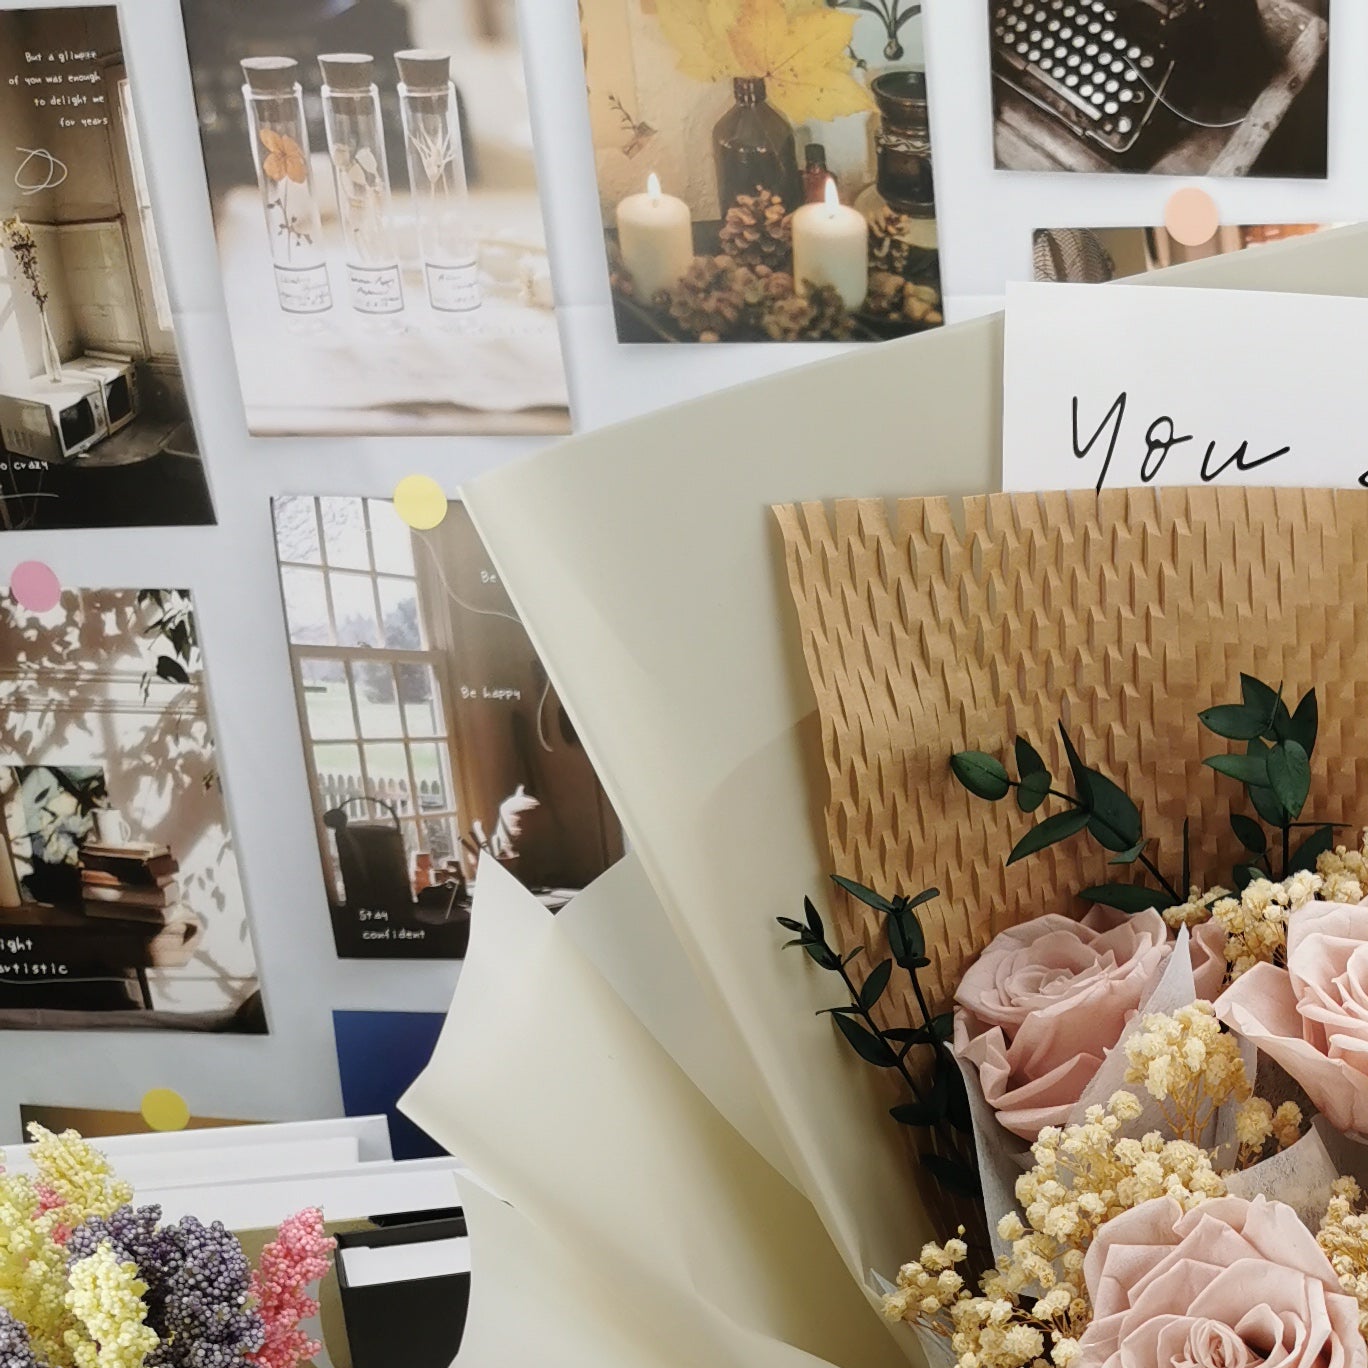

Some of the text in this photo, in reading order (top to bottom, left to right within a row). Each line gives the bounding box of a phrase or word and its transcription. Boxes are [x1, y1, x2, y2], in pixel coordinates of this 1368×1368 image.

[25, 51, 42, 63] But
[48, 53, 55, 61] a
[8, 70, 101, 86] of you was enough
[34, 94, 105, 107] to delight me
[60, 116, 108, 128] for years
[1071, 390, 1291, 499] You
[13, 460, 49, 471] crazy
[480, 570, 497, 584] Be
[460, 683, 521, 701] Be happy
[359, 907, 389, 922] Stay
[361, 926, 426, 940] confident
